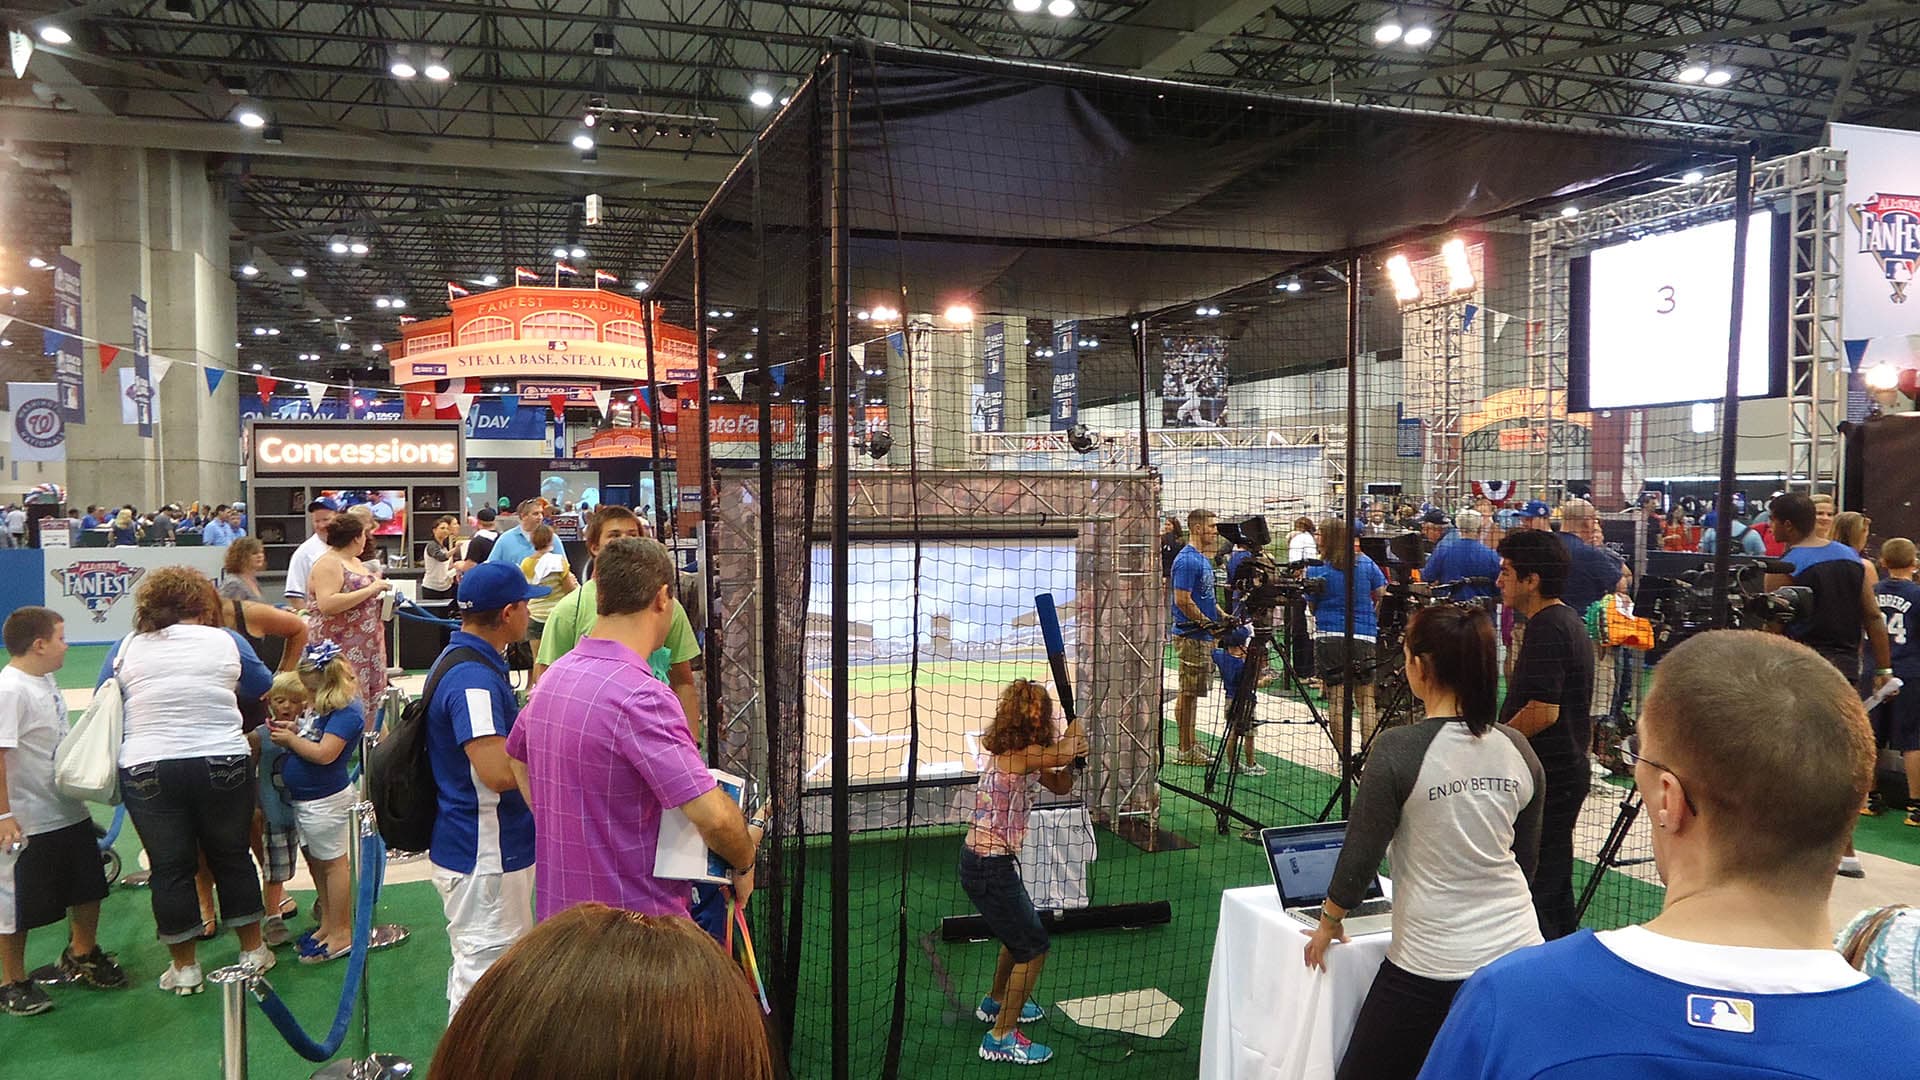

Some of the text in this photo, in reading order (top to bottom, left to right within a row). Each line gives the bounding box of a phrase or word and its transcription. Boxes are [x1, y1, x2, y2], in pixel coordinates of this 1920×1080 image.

[478, 297, 636, 320] FANFEST STADIUM
[1656, 285, 1676, 314] 3
[458, 353, 648, 370] STEAL A BASE, STEAL A TAC
[478, 415, 509, 429] DAY
[259, 437, 456, 465] Concessions
[1428, 777, 1520, 801] ENJOY BETTER
